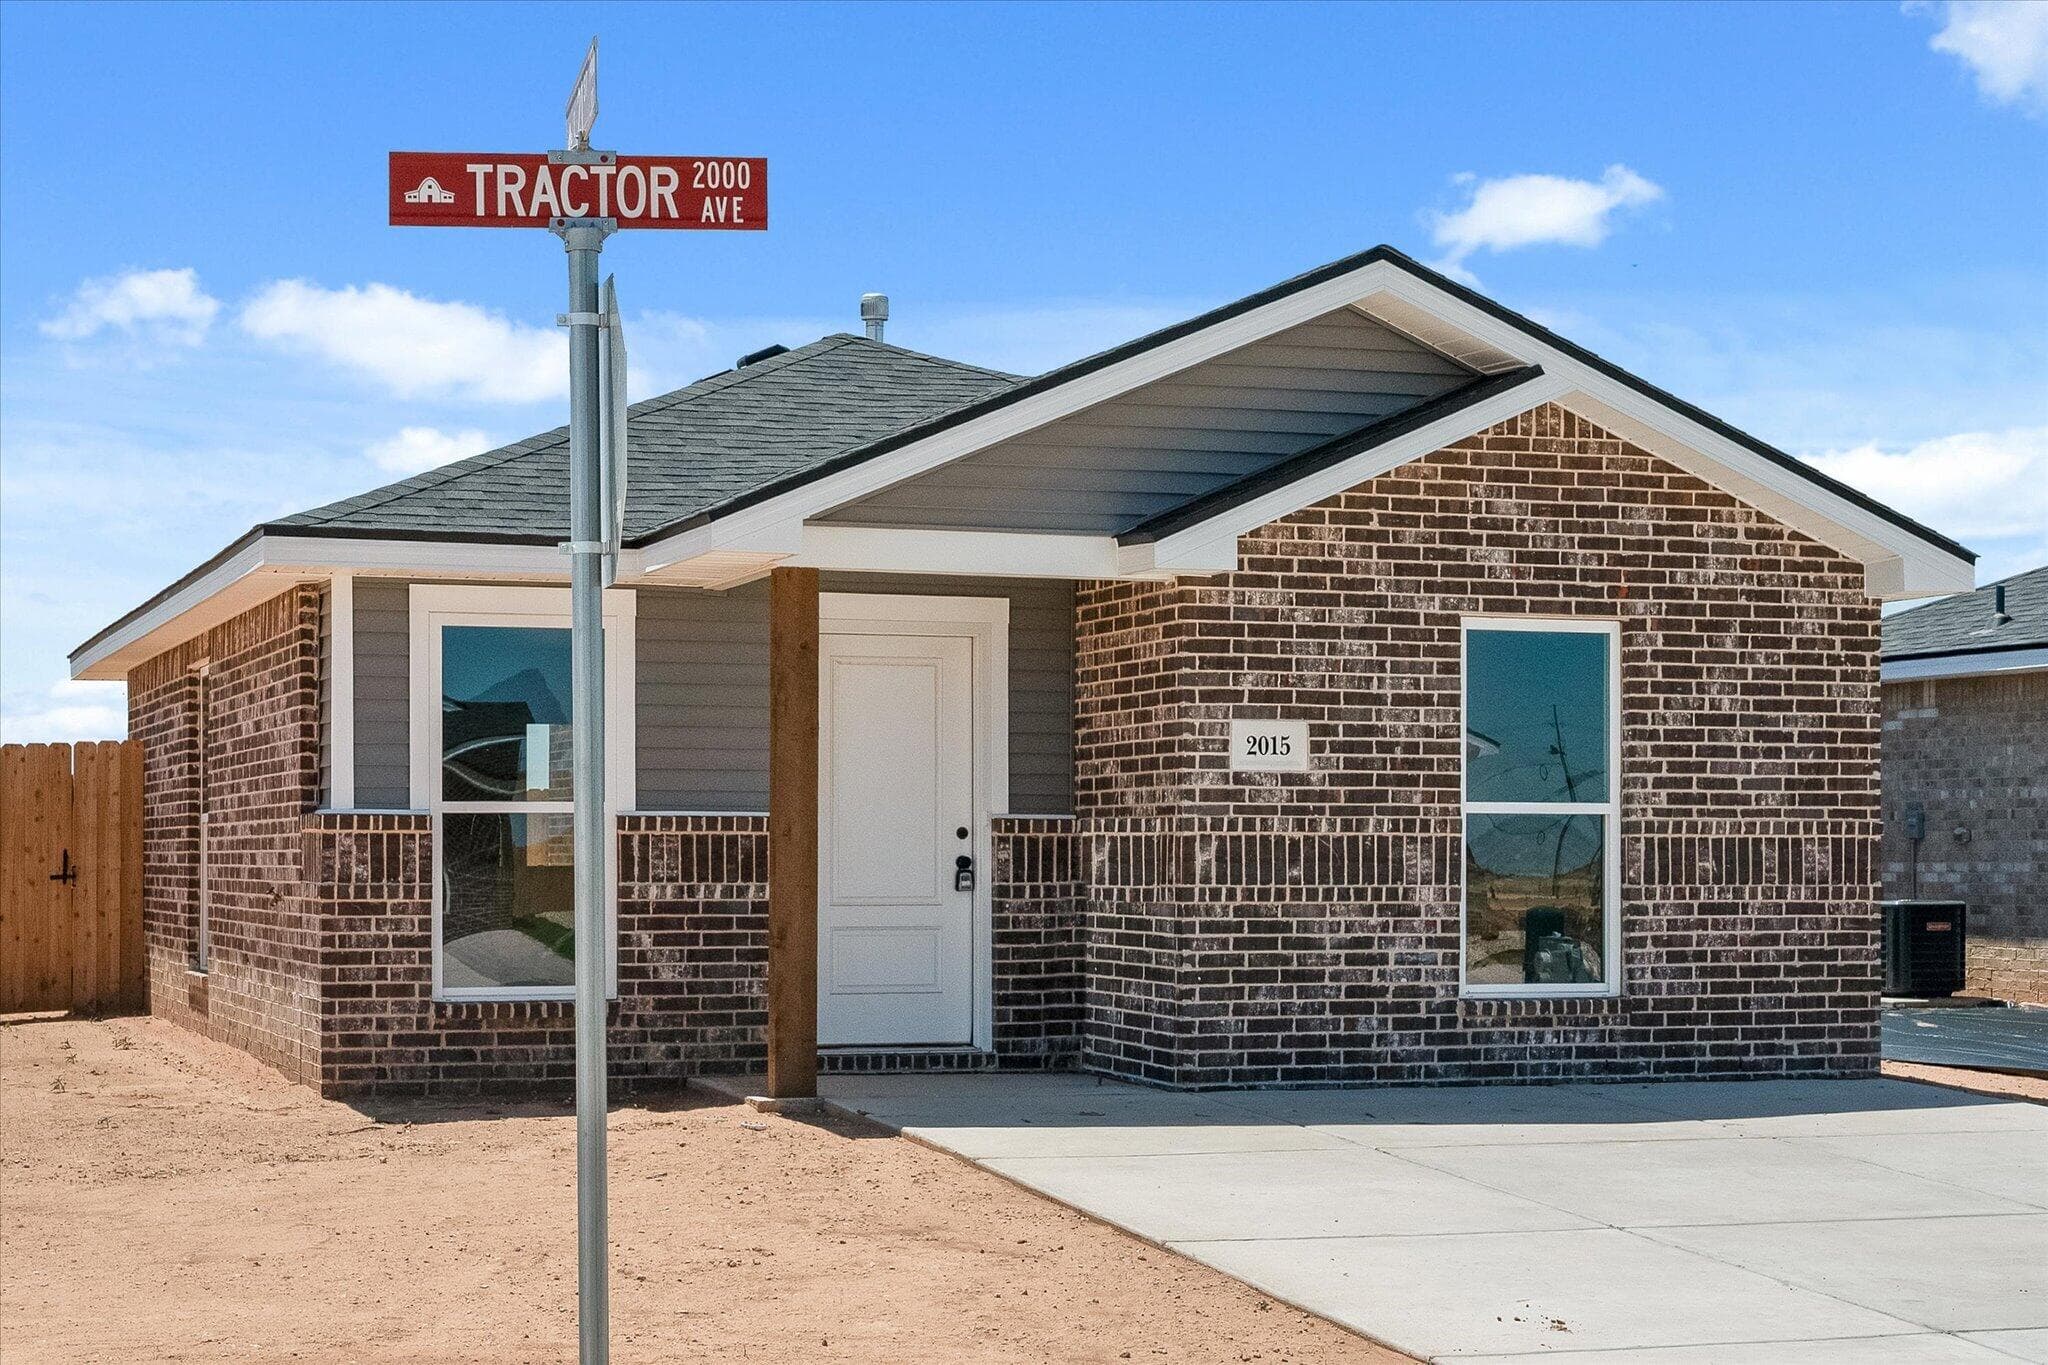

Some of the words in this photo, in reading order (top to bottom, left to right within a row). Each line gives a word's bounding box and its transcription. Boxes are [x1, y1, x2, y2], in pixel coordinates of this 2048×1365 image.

[692, 161, 751, 190] 2000
[466, 163, 680, 219] TRACTOR
[701, 196, 744, 224] AVE
[1246, 735, 1291, 756] 2015
